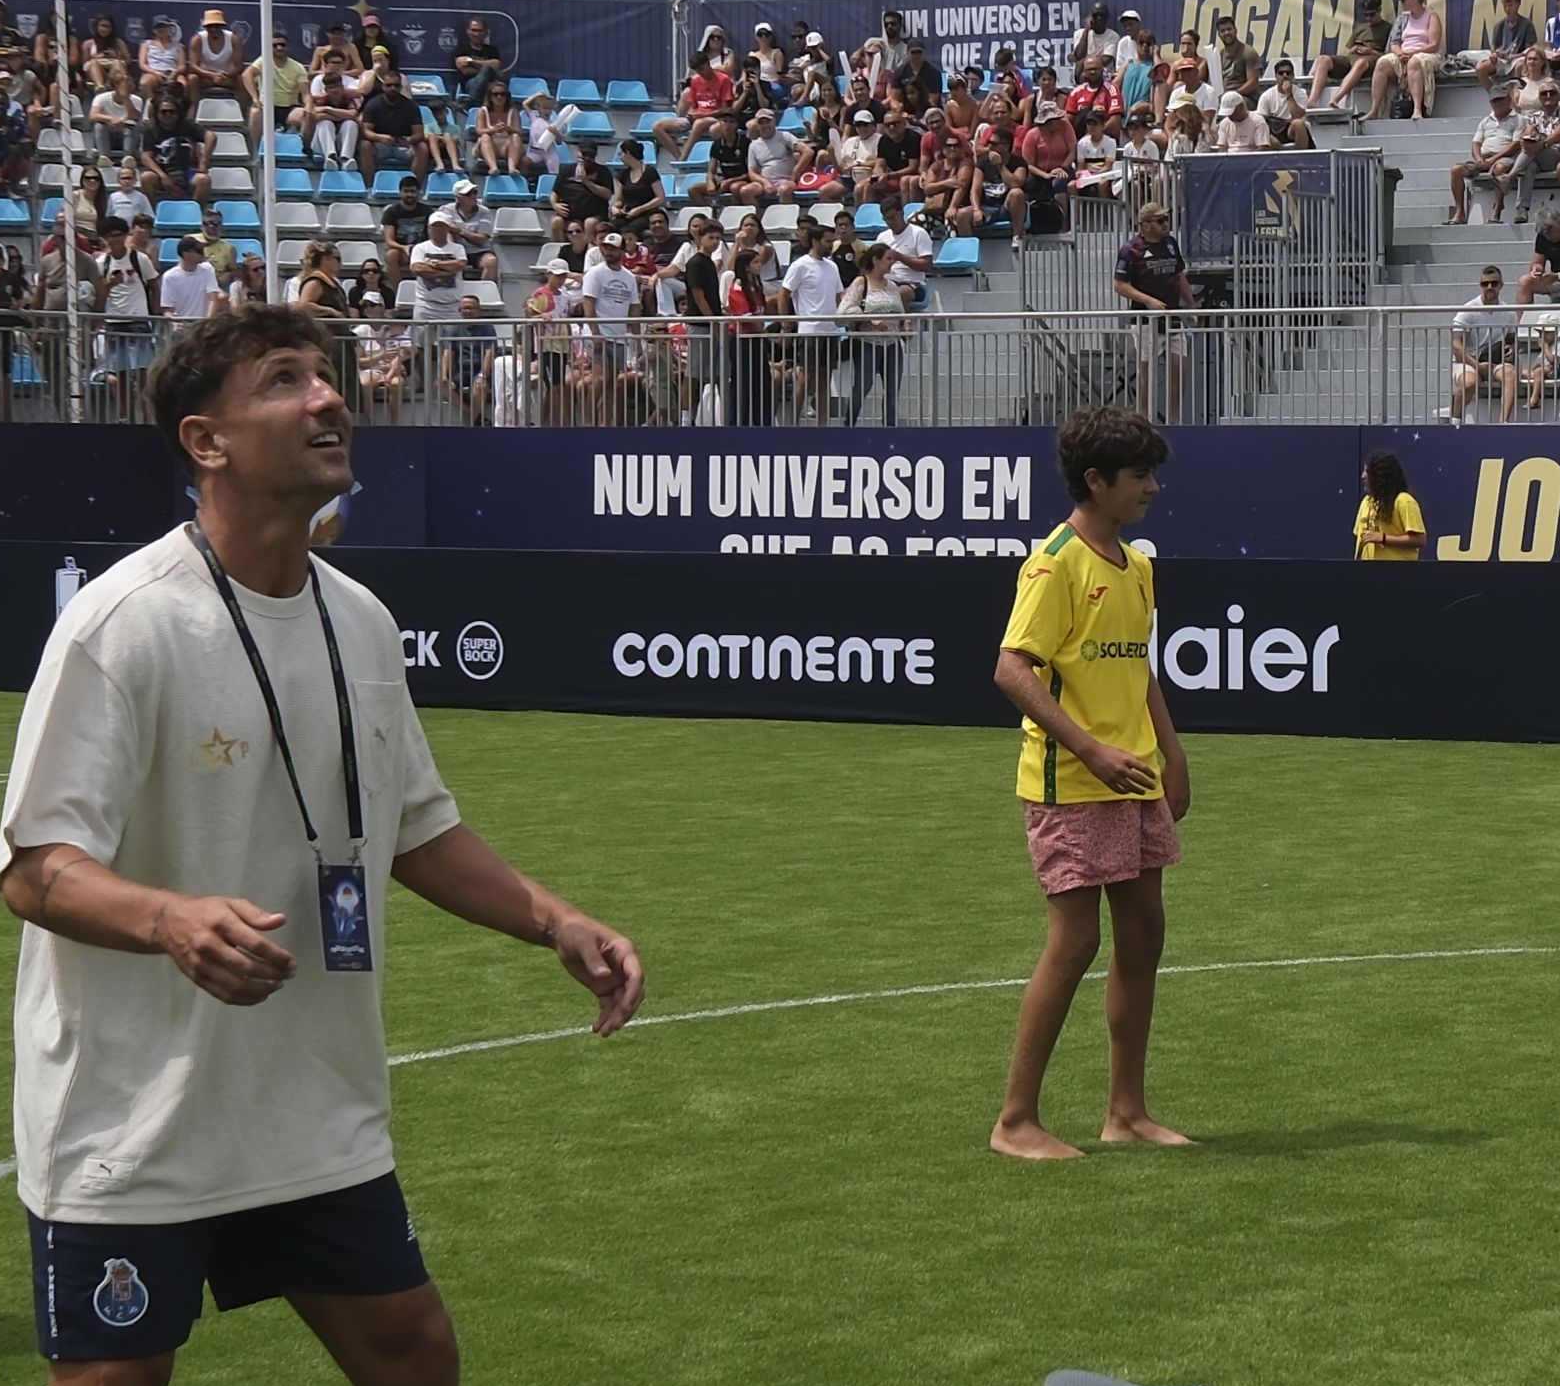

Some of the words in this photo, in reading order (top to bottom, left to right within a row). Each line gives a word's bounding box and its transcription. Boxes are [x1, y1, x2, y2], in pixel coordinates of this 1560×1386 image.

[882, 8, 929, 39] UM
[935, 3, 1041, 37] UNIVERSO
[1048, 1, 1080, 31] EM
[941, 42, 982, 71] QUE
[593, 453, 693, 516] NUM
[708, 454, 944, 521] UNIVERSO
[962, 456, 1032, 521] EM
[402, 629, 440, 667] CK
[462, 638, 498, 651] SUPER
[463, 650, 497, 663] BOCK
